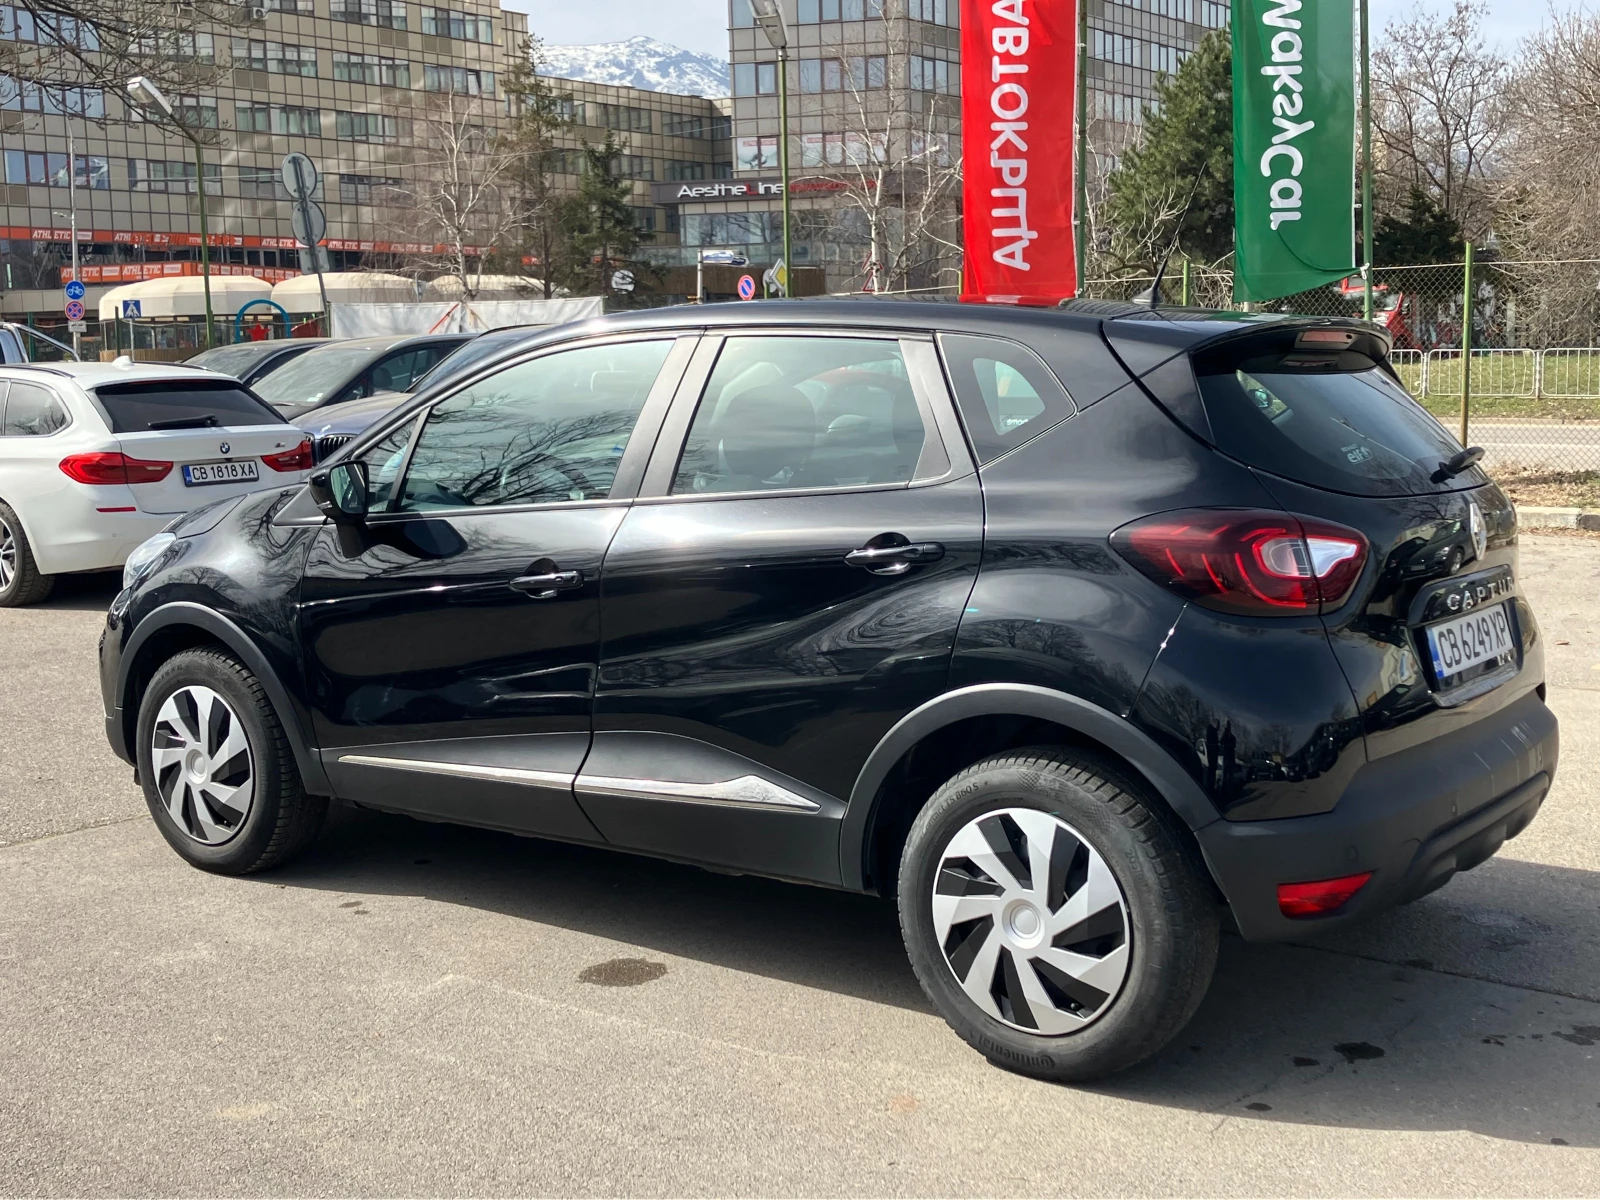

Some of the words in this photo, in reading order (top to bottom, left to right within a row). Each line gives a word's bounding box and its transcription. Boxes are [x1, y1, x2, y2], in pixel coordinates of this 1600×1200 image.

[32, 230, 71, 240] ATHLETIC
[261, 238, 294, 247] ATHLETIC
[61, 267, 100, 278] ATETIC
[122, 264, 162, 276] ATHLETIC
[192, 466, 208, 481] CB
[210, 464, 238, 479] 1818
[239, 463, 256, 477] XA
[1446, 576, 1515, 611] CAPTUR
[1438, 628, 1463, 669] CB
[1460, 616, 1493, 660] 6249
[1488, 610, 1507, 649] XP
